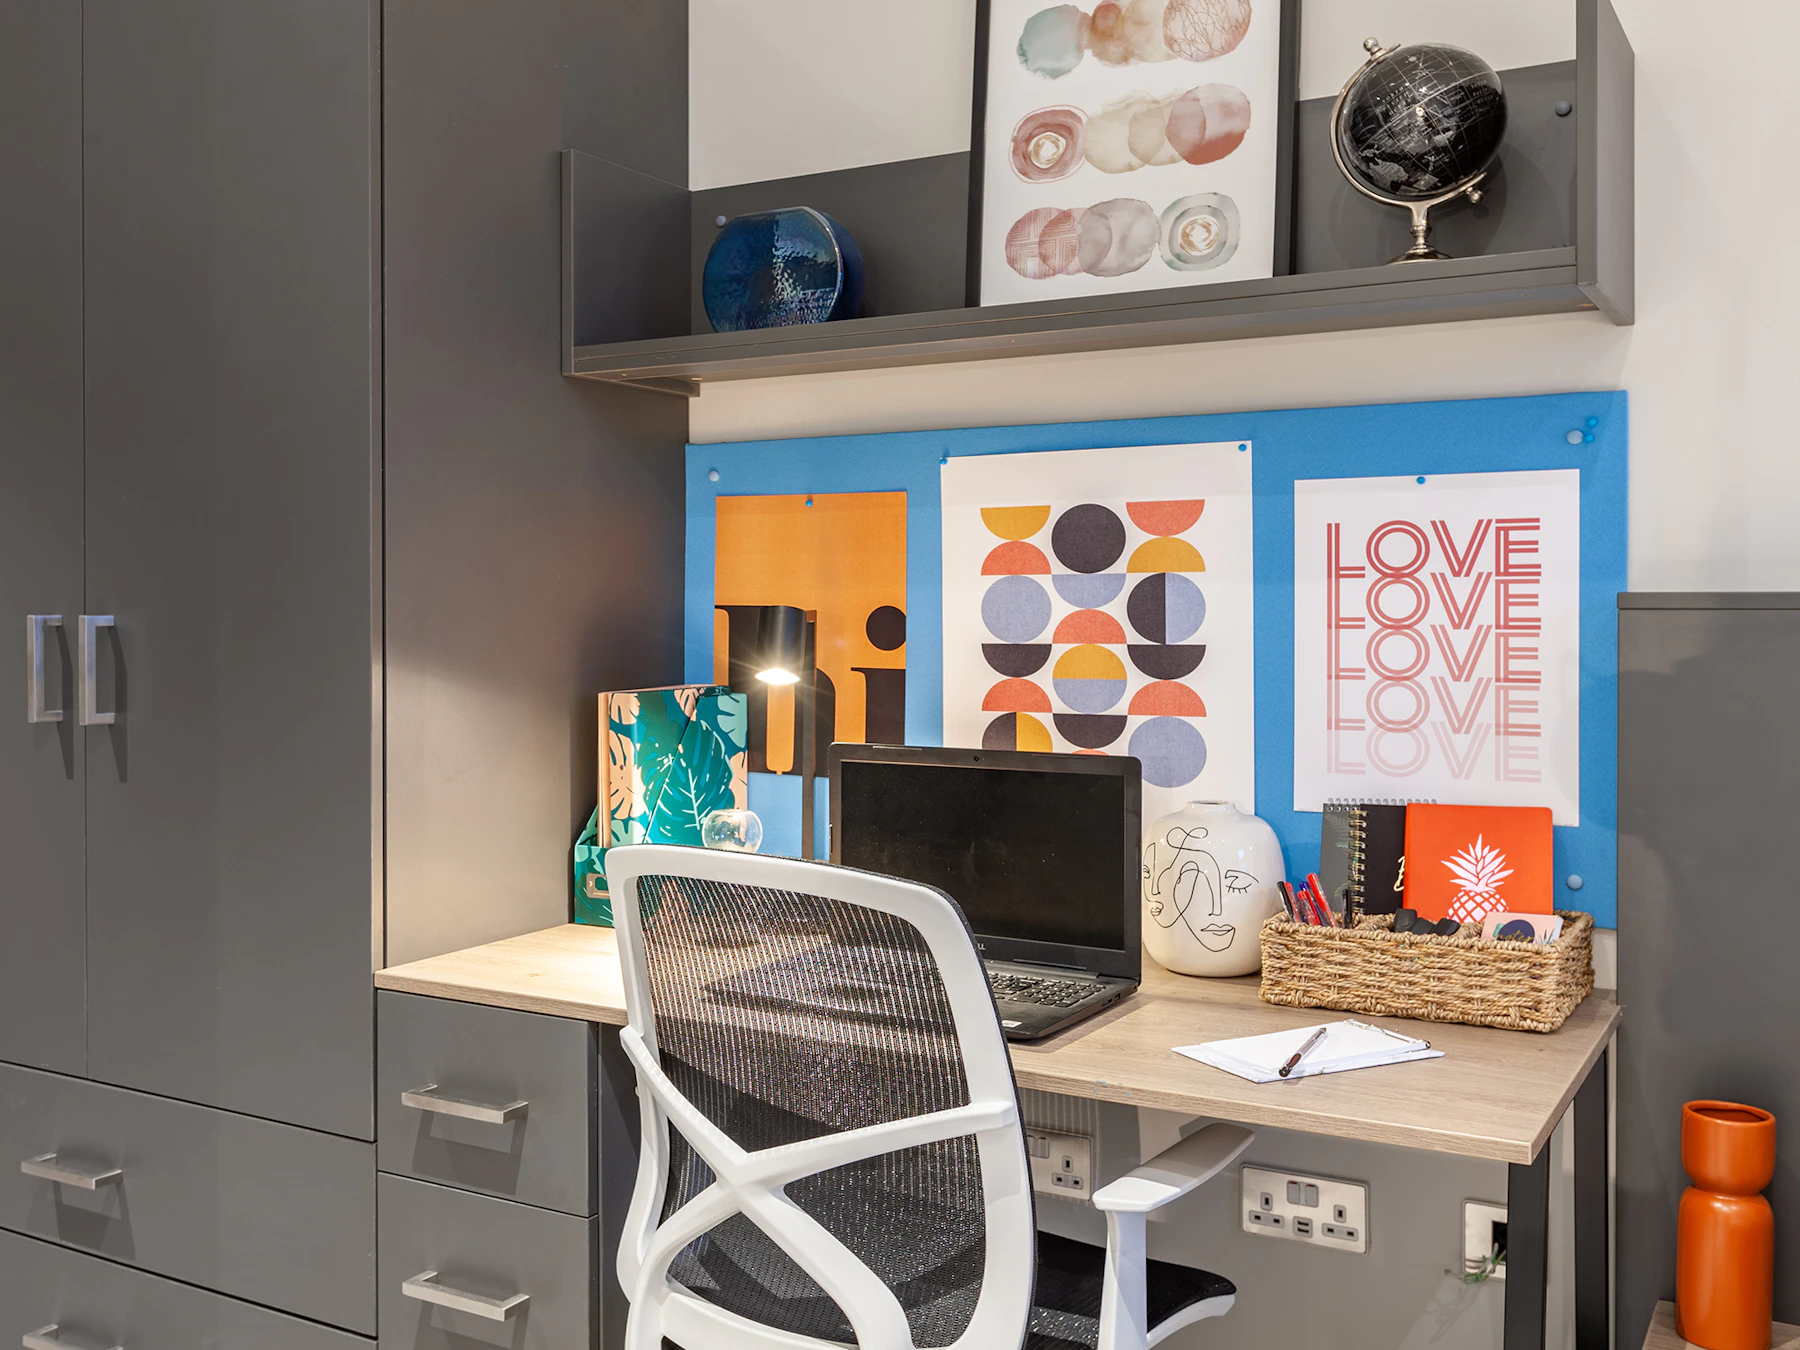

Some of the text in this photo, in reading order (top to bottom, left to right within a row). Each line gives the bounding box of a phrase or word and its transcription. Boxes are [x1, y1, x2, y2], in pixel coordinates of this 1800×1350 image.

[1327, 518, 1541, 578] LOVE
[1327, 572, 1541, 630] LOVE
[1327, 624, 1541, 683] LOVE
[1327, 676, 1541, 737] LOVE
[1327, 721, 1541, 783] LOVE
